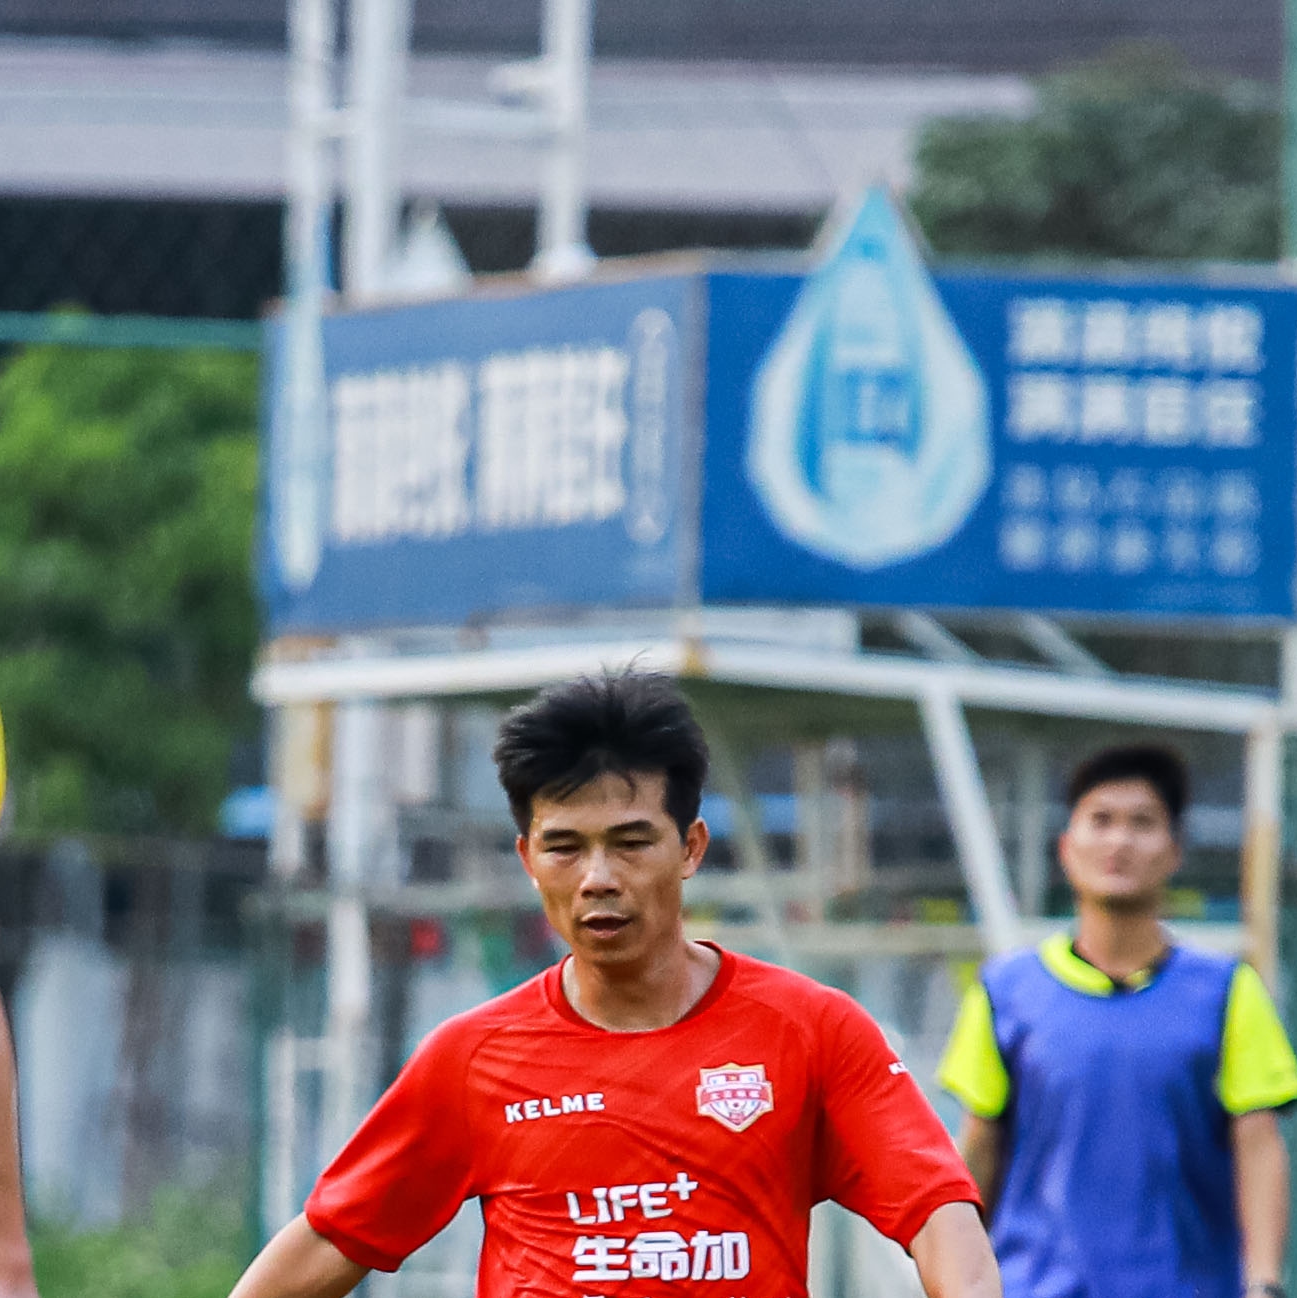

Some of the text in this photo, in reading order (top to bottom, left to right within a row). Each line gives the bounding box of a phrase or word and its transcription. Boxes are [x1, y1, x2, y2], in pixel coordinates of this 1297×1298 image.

[504, 1093, 606, 1124] KELME
[572, 1230, 751, 1282] 生命加
